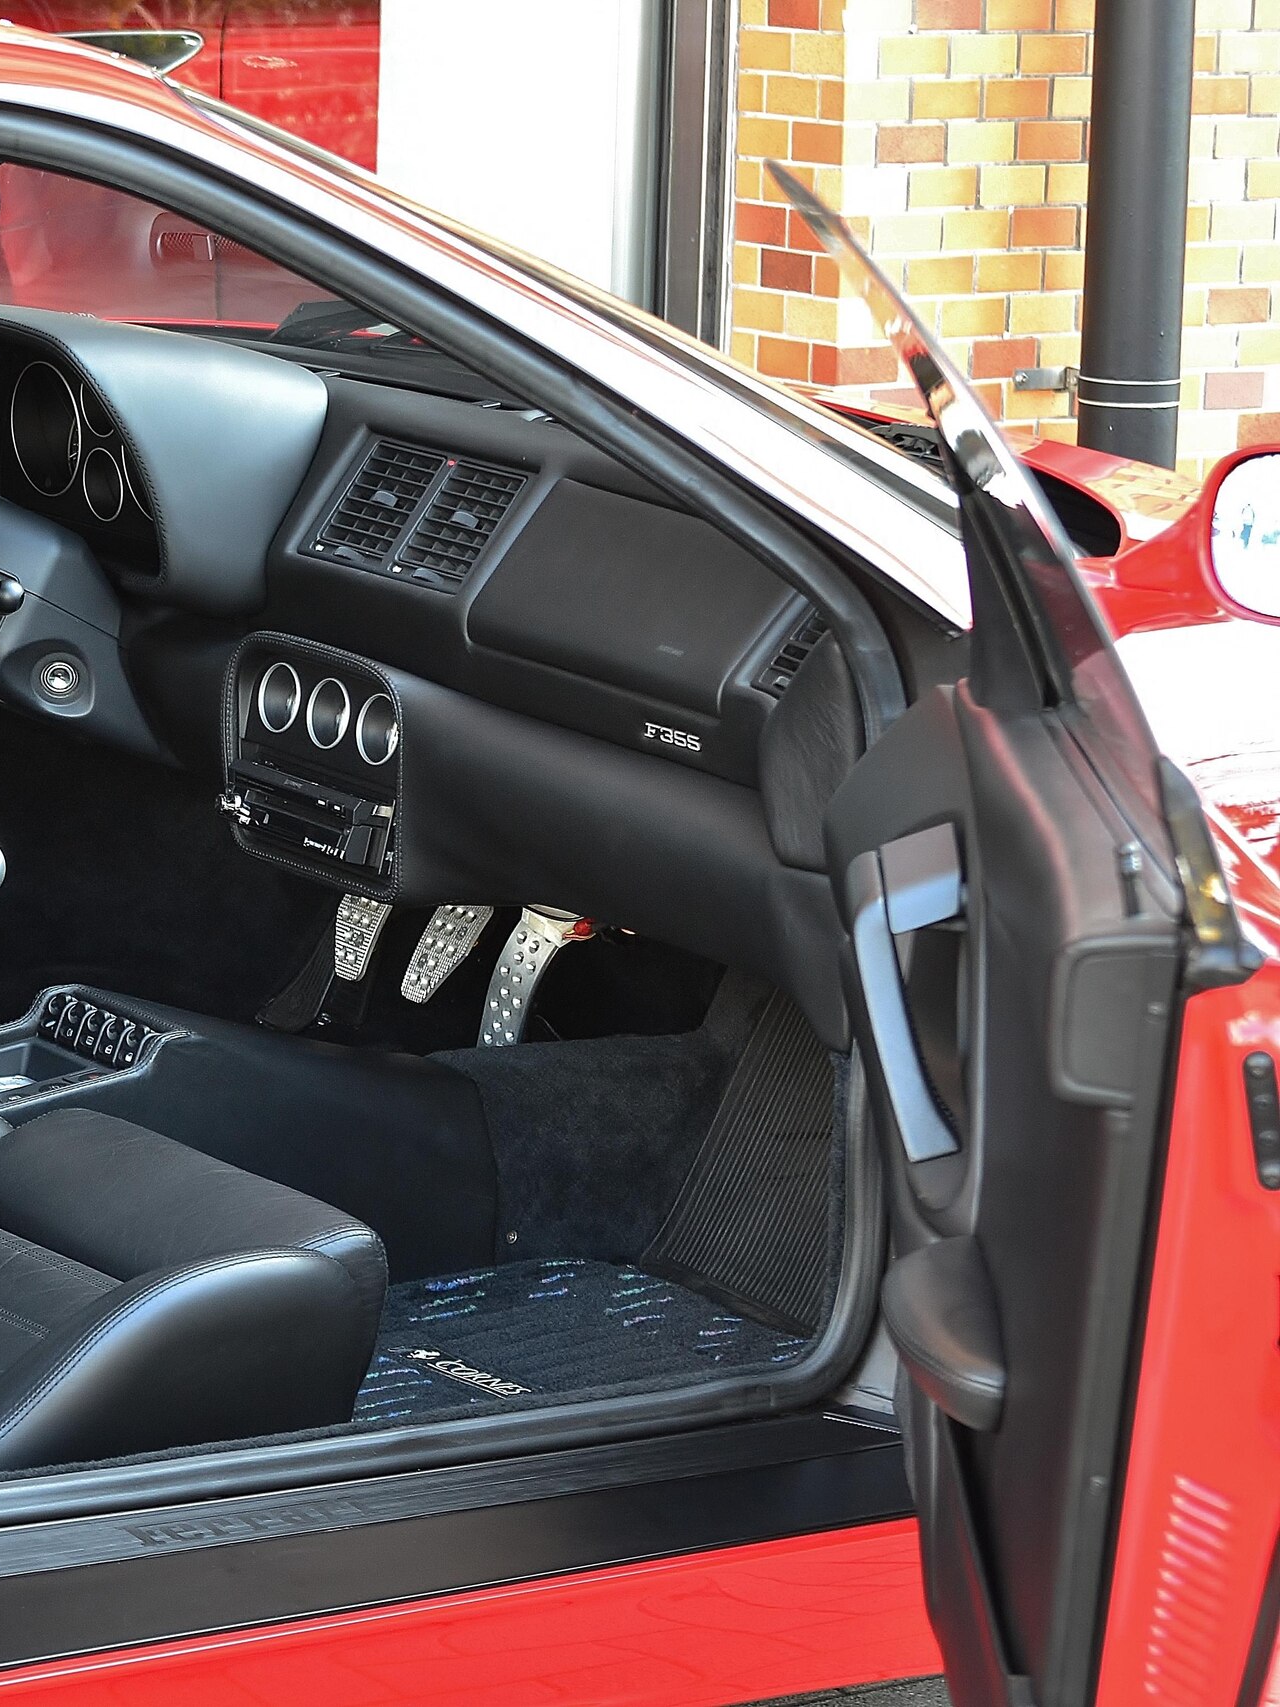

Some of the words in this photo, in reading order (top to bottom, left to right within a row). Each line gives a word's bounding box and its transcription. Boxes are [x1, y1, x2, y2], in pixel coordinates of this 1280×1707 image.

[644, 722, 702, 752] F355
[435, 1359, 532, 1395] CORNES
[124, 1497, 367, 1548] Ferrari
